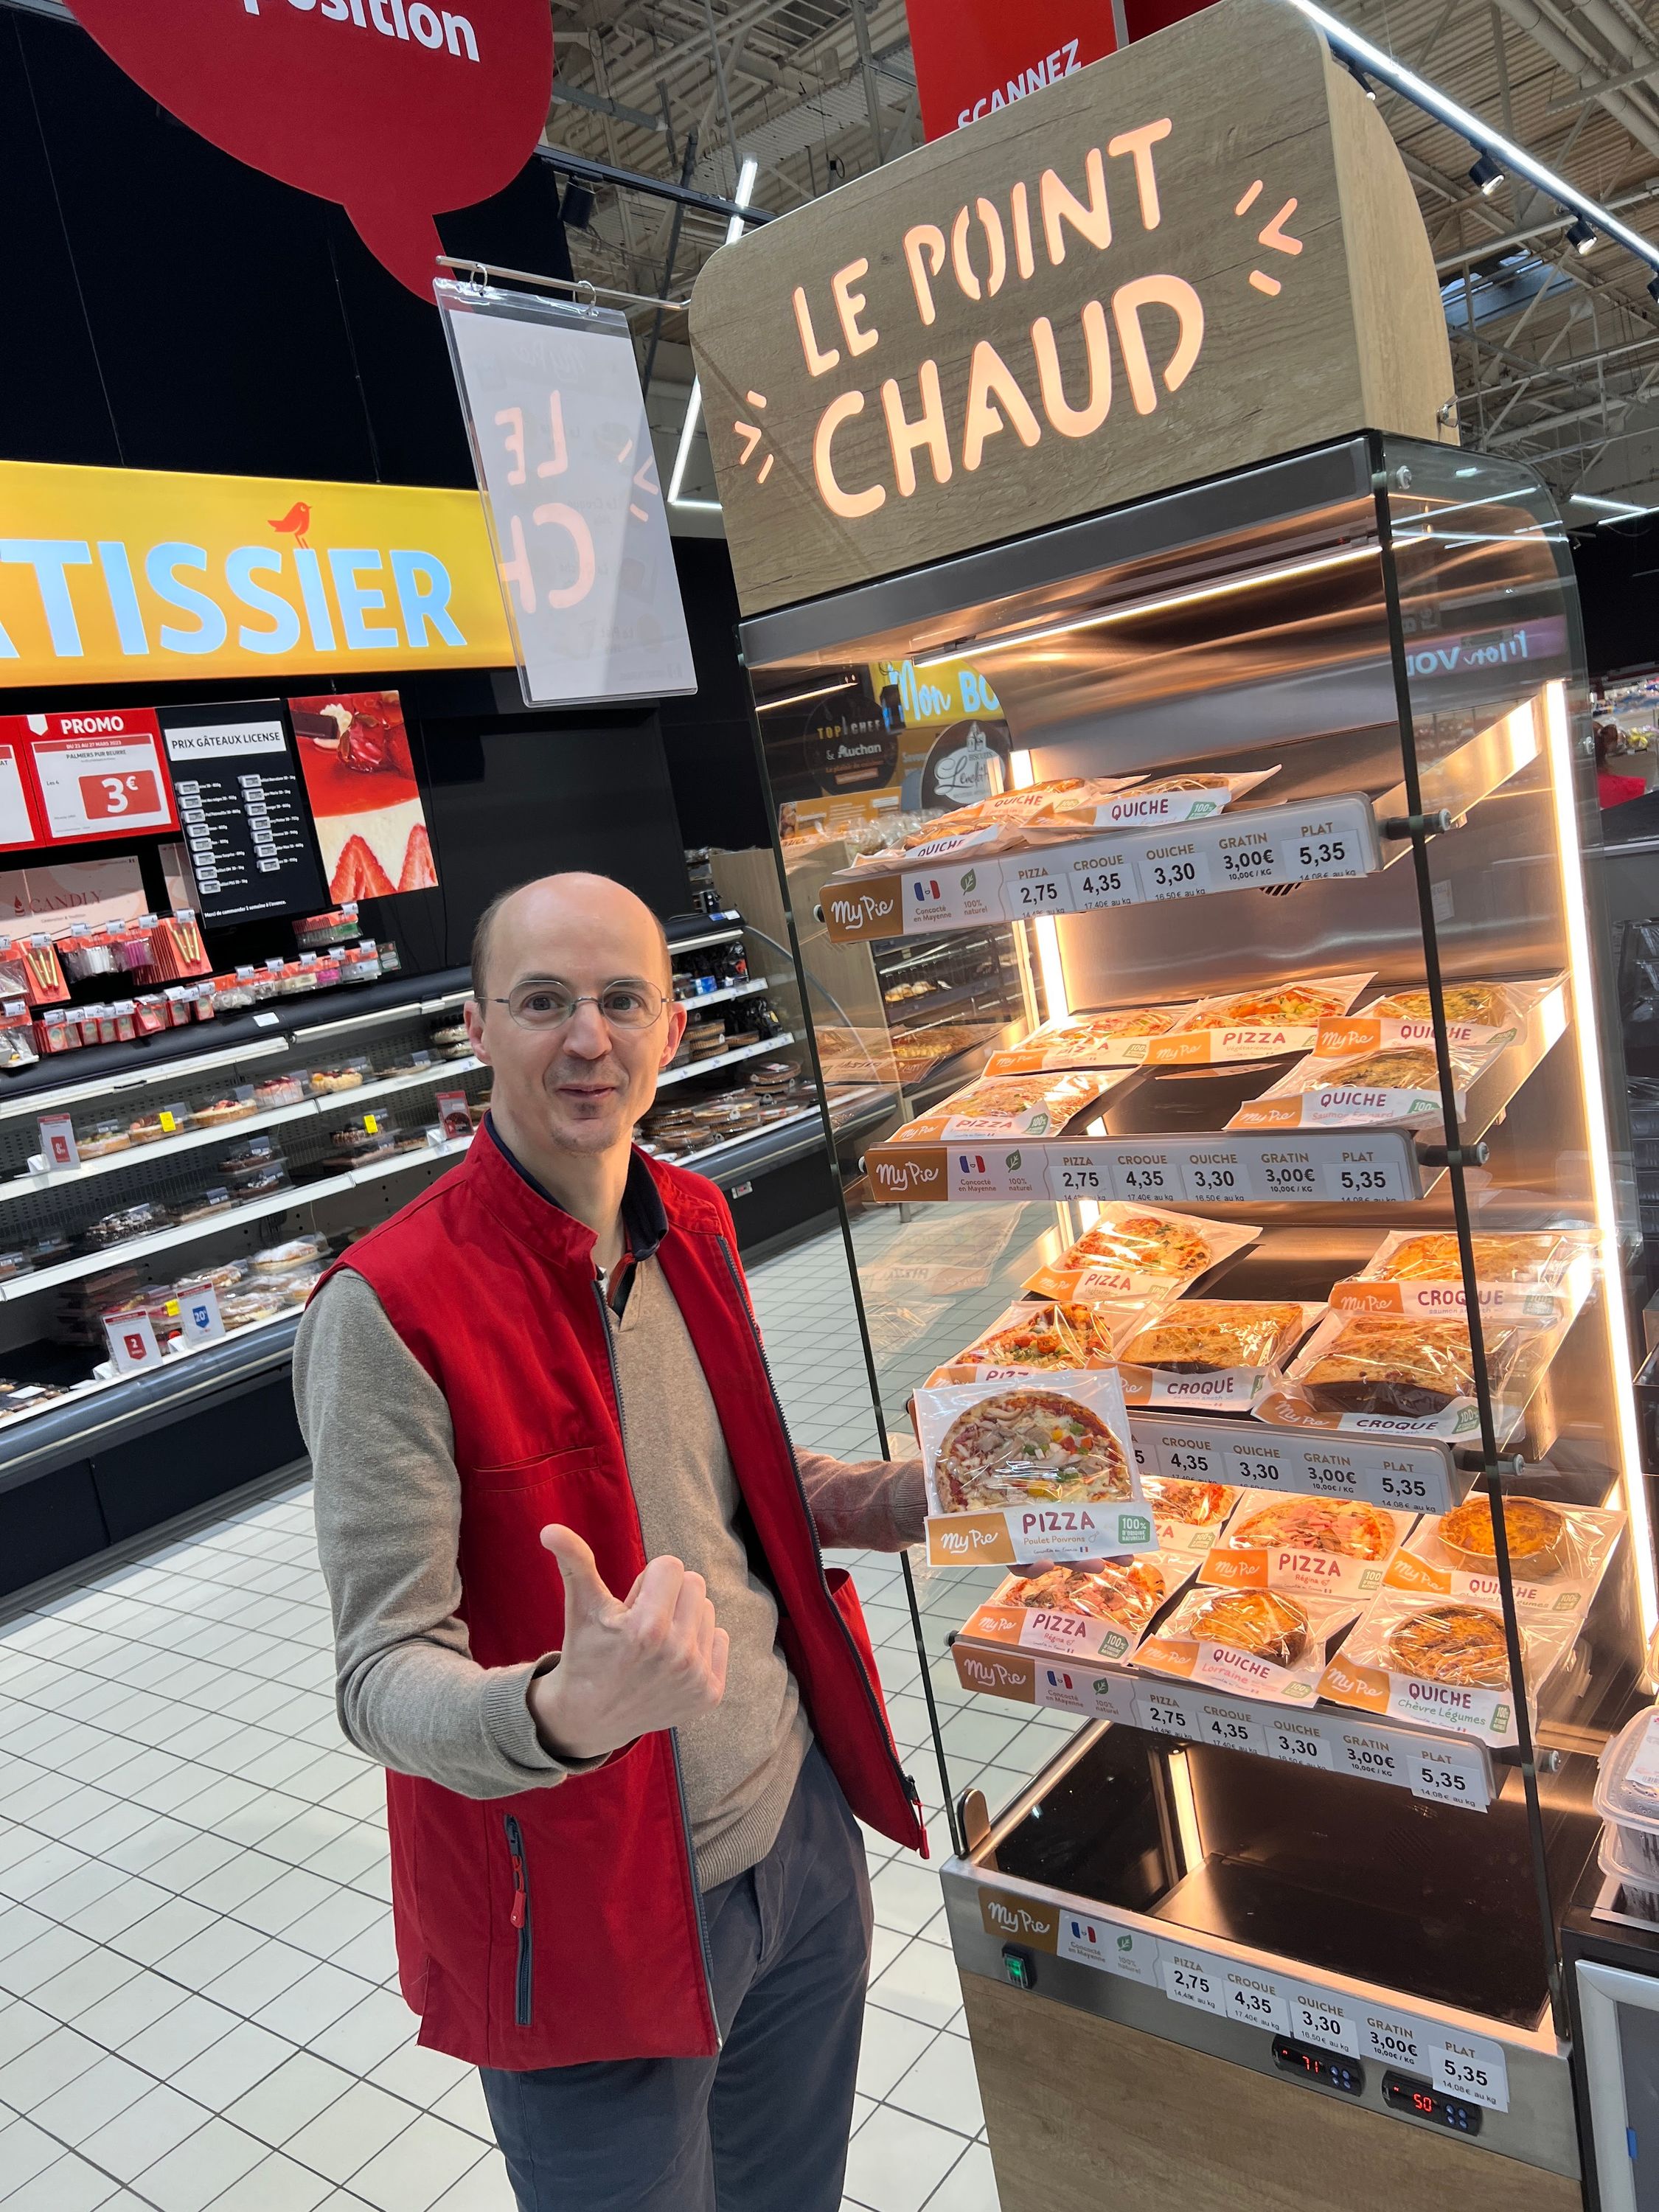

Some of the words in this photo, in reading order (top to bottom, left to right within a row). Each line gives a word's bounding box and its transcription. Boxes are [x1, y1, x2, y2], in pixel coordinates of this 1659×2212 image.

[243, 0, 480, 62] sition
[957, 38, 1082, 129] SCANNEZ
[792, 257, 879, 377] LE
[903, 117, 1172, 326] POINT
[813, 274, 1204, 518] CHAUD
[0, 538, 467, 658] TISSIER
[61, 716, 124, 734] PROMO
[817, 726, 841, 740] TOP
[172, 740, 195, 749] PRIX
[197, 735, 241, 747] GÂTEAUX
[244, 732, 280, 742] LICENSE
[66, 751, 94, 759] PALMIERS
[838, 743, 882, 758] Auchan
[995, 796, 1043, 807] QUICHE
[1112, 799, 1169, 821] QUICHE
[1301, 822, 1333, 837] PLAT
[1219, 832, 1268, 849] GRATIN
[1223, 849, 1274, 872] 3,00€
[1299, 841, 1346, 867] 5,35
[1018, 867, 1049, 880] PIZZA
[1154, 863, 1195, 886] 3,30
[1228, 871, 1253, 880] 10,00€
[1083, 873, 1121, 895] 4,35
[30, 890, 102, 913] CANDLY
[1020, 883, 1057, 905] 2,75
[916, 906, 946, 915] Concocté
[964, 900, 982, 908] 100%
[964, 906, 987, 915] naturel
[923, 912, 951, 922] Mayenne
[1222, 1032, 1286, 1046] PIZZA
[1401, 1025, 1472, 1040] QUIHE
[1320, 1092, 1387, 1107] QUICHE
[956, 1119, 1013, 1130] PIZZA
[1062, 1157, 1093, 1166] PIZZA
[1189, 1153, 1237, 1165] QUICHE
[1261, 1152, 1309, 1164] GRATIN
[1342, 1152, 1374, 1162] PLAT
[1062, 1172, 1099, 1189] 2,75
[1126, 1170, 1164, 1188] 4,35
[1194, 1169, 1235, 1189] 3,30
[1265, 1169, 1315, 1185] 3,00€
[1340, 1171, 1386, 1192] 5,35
[967, 1185, 997, 1193] Mayenne
[1270, 1185, 1294, 1194] 10,00€
[1085, 1273, 1130, 1290] PIZZA
[1419, 1289, 1504, 1307] CROQUE
[1166, 1377, 1234, 1396] CROQUE
[1357, 1418, 1437, 1432] CROQUE
[1162, 1436, 1211, 1451] CROQUE
[1233, 1444, 1281, 1458] QUICHE
[1170, 1453, 1208, 1472] 4,35
[1304, 1451, 1351, 1466] GRATIN
[1383, 1461, 1413, 1473] PLAT
[1239, 1461, 1279, 1481] 3,30
[1308, 1467, 1357, 1485] 3,00€
[1312, 1482, 1338, 1492] 10,00€
[1343, 1486, 1354, 1494] KG
[1382, 1478, 1426, 1498] 5,35
[1023, 1511, 1096, 1534] PIZZA
[1122, 1517, 1147, 1530] 100%
[1023, 1536, 1050, 1545] Poulet
[1051, 1534, 1086, 1544] Poivrons
[1279, 1554, 1341, 1577] PIZZA
[1295, 1574, 1319, 1585] Régina
[1469, 1579, 1537, 1599] QUIHE
[1033, 1613, 1086, 1638] PIZZA
[1043, 1632, 1065, 1644] Régina
[1107, 1634, 1127, 1650] 100%
[1212, 1648, 1271, 1680] QUICHE
[1201, 1662, 1249, 1686] Lorraine
[1150, 1694, 1180, 1707] PIZZA
[1408, 1682, 1472, 1711] QUICHE
[1150, 1708, 1186, 1727] 2,75
[1397, 1697, 1437, 1721] Chèvre
[1439, 1705, 1486, 1728] Légumes
[1211, 1720, 1249, 1741] 4,35
[1278, 1736, 1318, 1758] 3,30
[1343, 1734, 1390, 1753] GRATIN
[1347, 1748, 1395, 1770] 3,00€
[1421, 1750, 1453, 1764] PLAT
[1351, 1762, 1377, 1775] 10,00€
[1380, 1769, 1393, 1778] KG
[1421, 1767, 1467, 1792] 5,35
[1174, 1955, 1203, 1972] PIZZA
[1173, 1970, 1210, 1993] 2,75
[1228, 1973, 1276, 1995] CROQUE
[1234, 1991, 1272, 2014] 4,35
[1260, 2018, 1270, 2026] au
[1270, 2020, 1279, 2031] kg
[1303, 2011, 1340, 2036] 3,30
[1367, 2017, 1413, 2039] GRATIN
[1329, 2040, 1338, 2048] au
[1340, 2042, 1349, 2053] kg
[1370, 2031, 1418, 2057] 3,00€
[1444, 2041, 1475, 2059] PLAT
[1302, 2056, 1318, 2073] 71
[1374, 2048, 1399, 2059] 10,00€
[1404, 2056, 1415, 2065] KG
[1444, 2059, 1489, 2087] 5,35
[1413, 2093, 1433, 2113] 50
[1485, 2094, 1496, 2105] kg
